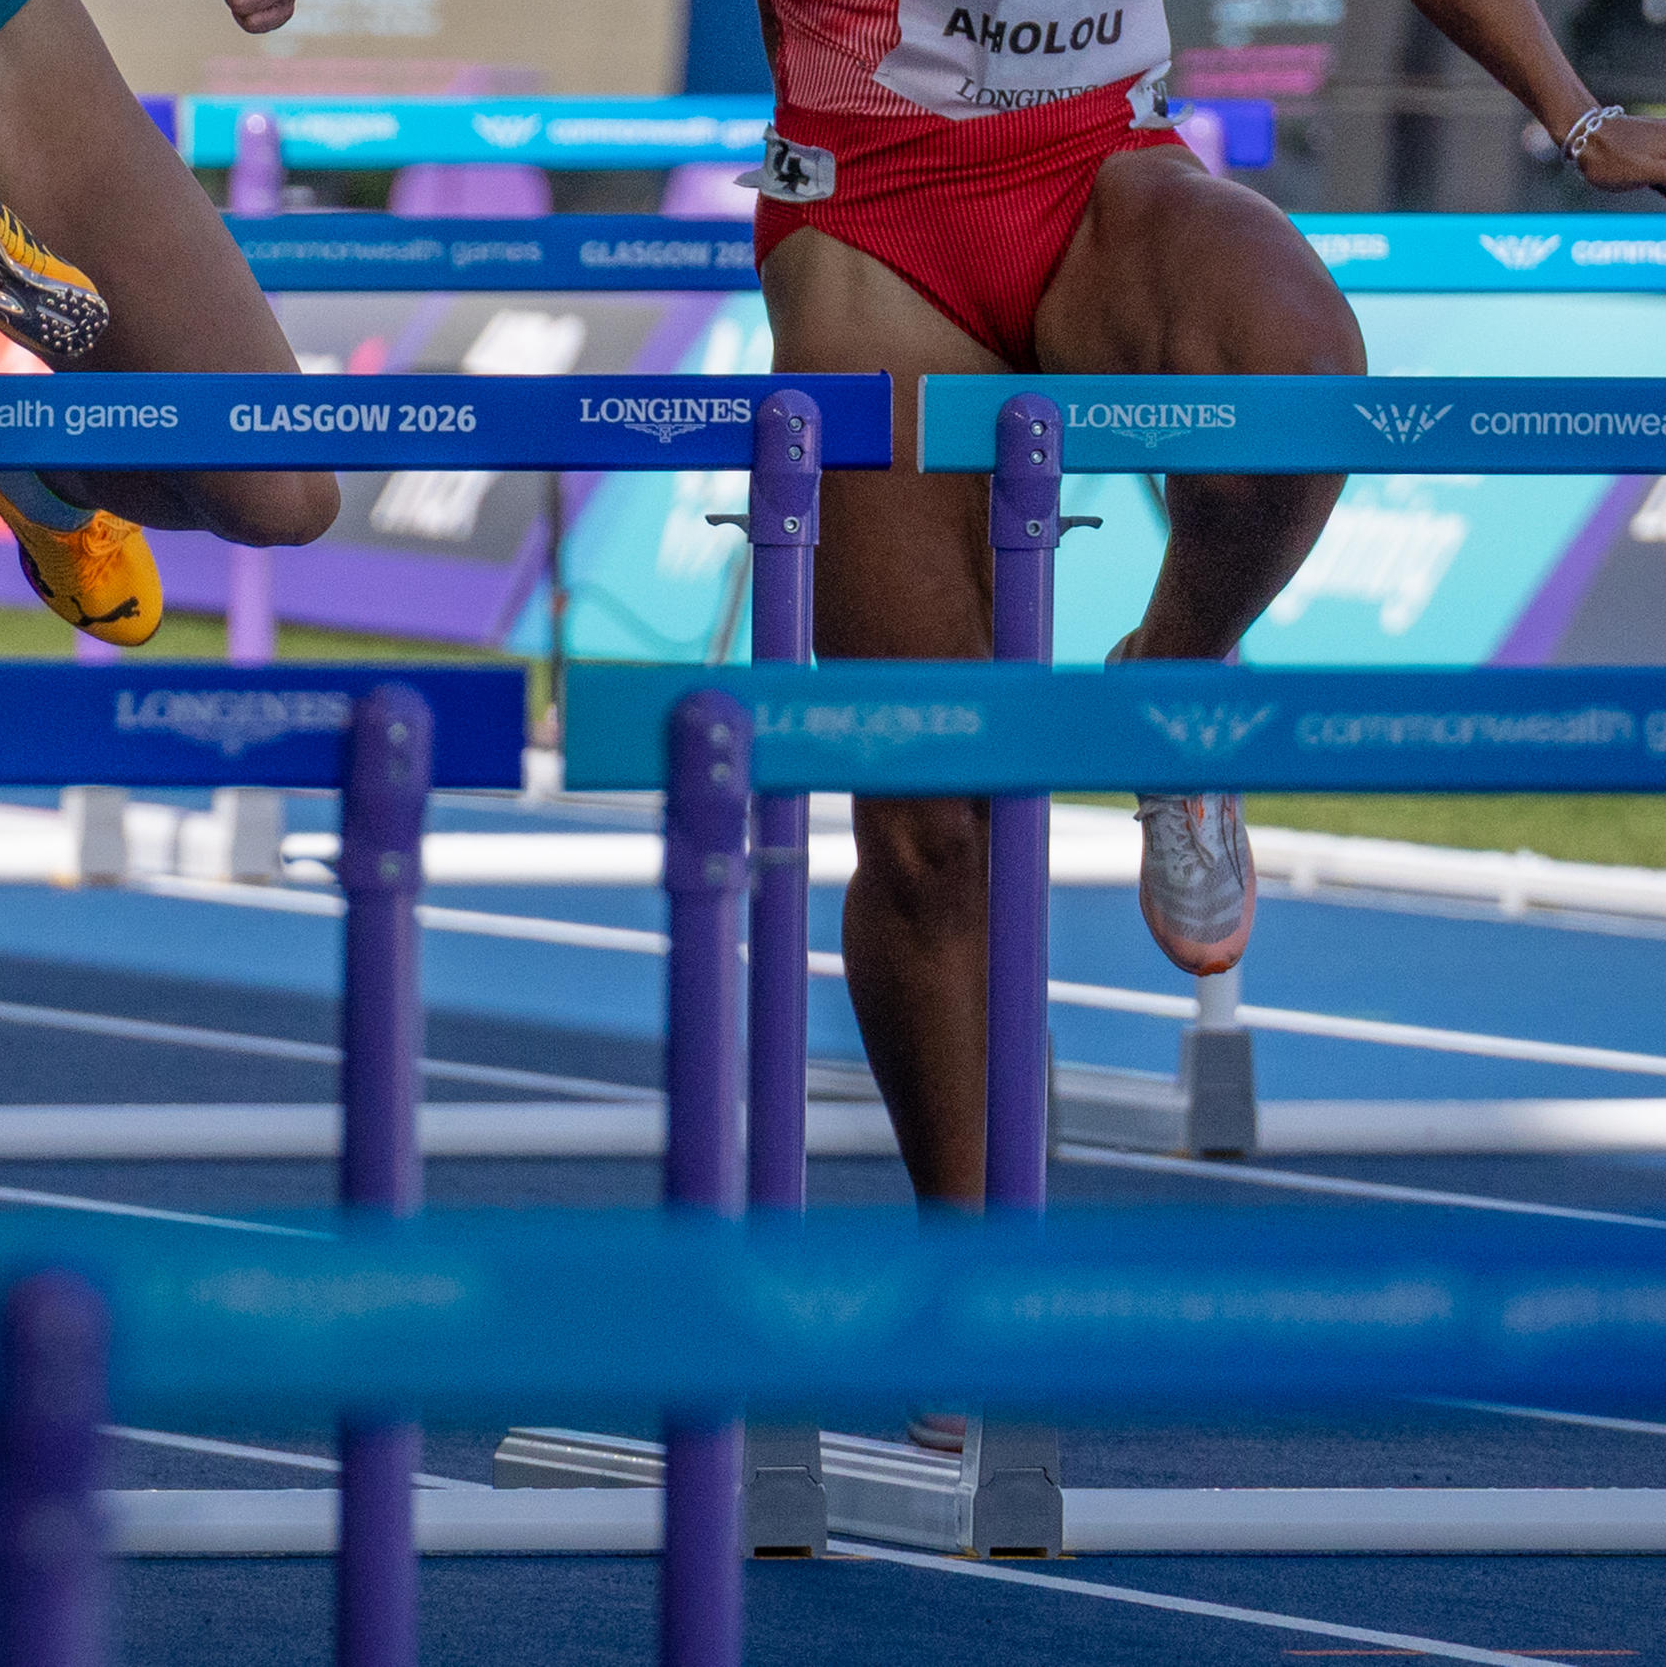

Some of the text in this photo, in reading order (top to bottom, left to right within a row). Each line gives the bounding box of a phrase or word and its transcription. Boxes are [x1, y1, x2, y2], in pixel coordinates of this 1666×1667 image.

[942, 7, 1123, 55] AHOLOU
[65, 404, 178, 435] games
[230, 404, 477, 433] GLASGOW 2026
[580, 398, 752, 423] LONGINES
[1067, 404, 1236, 428] LONGINES
